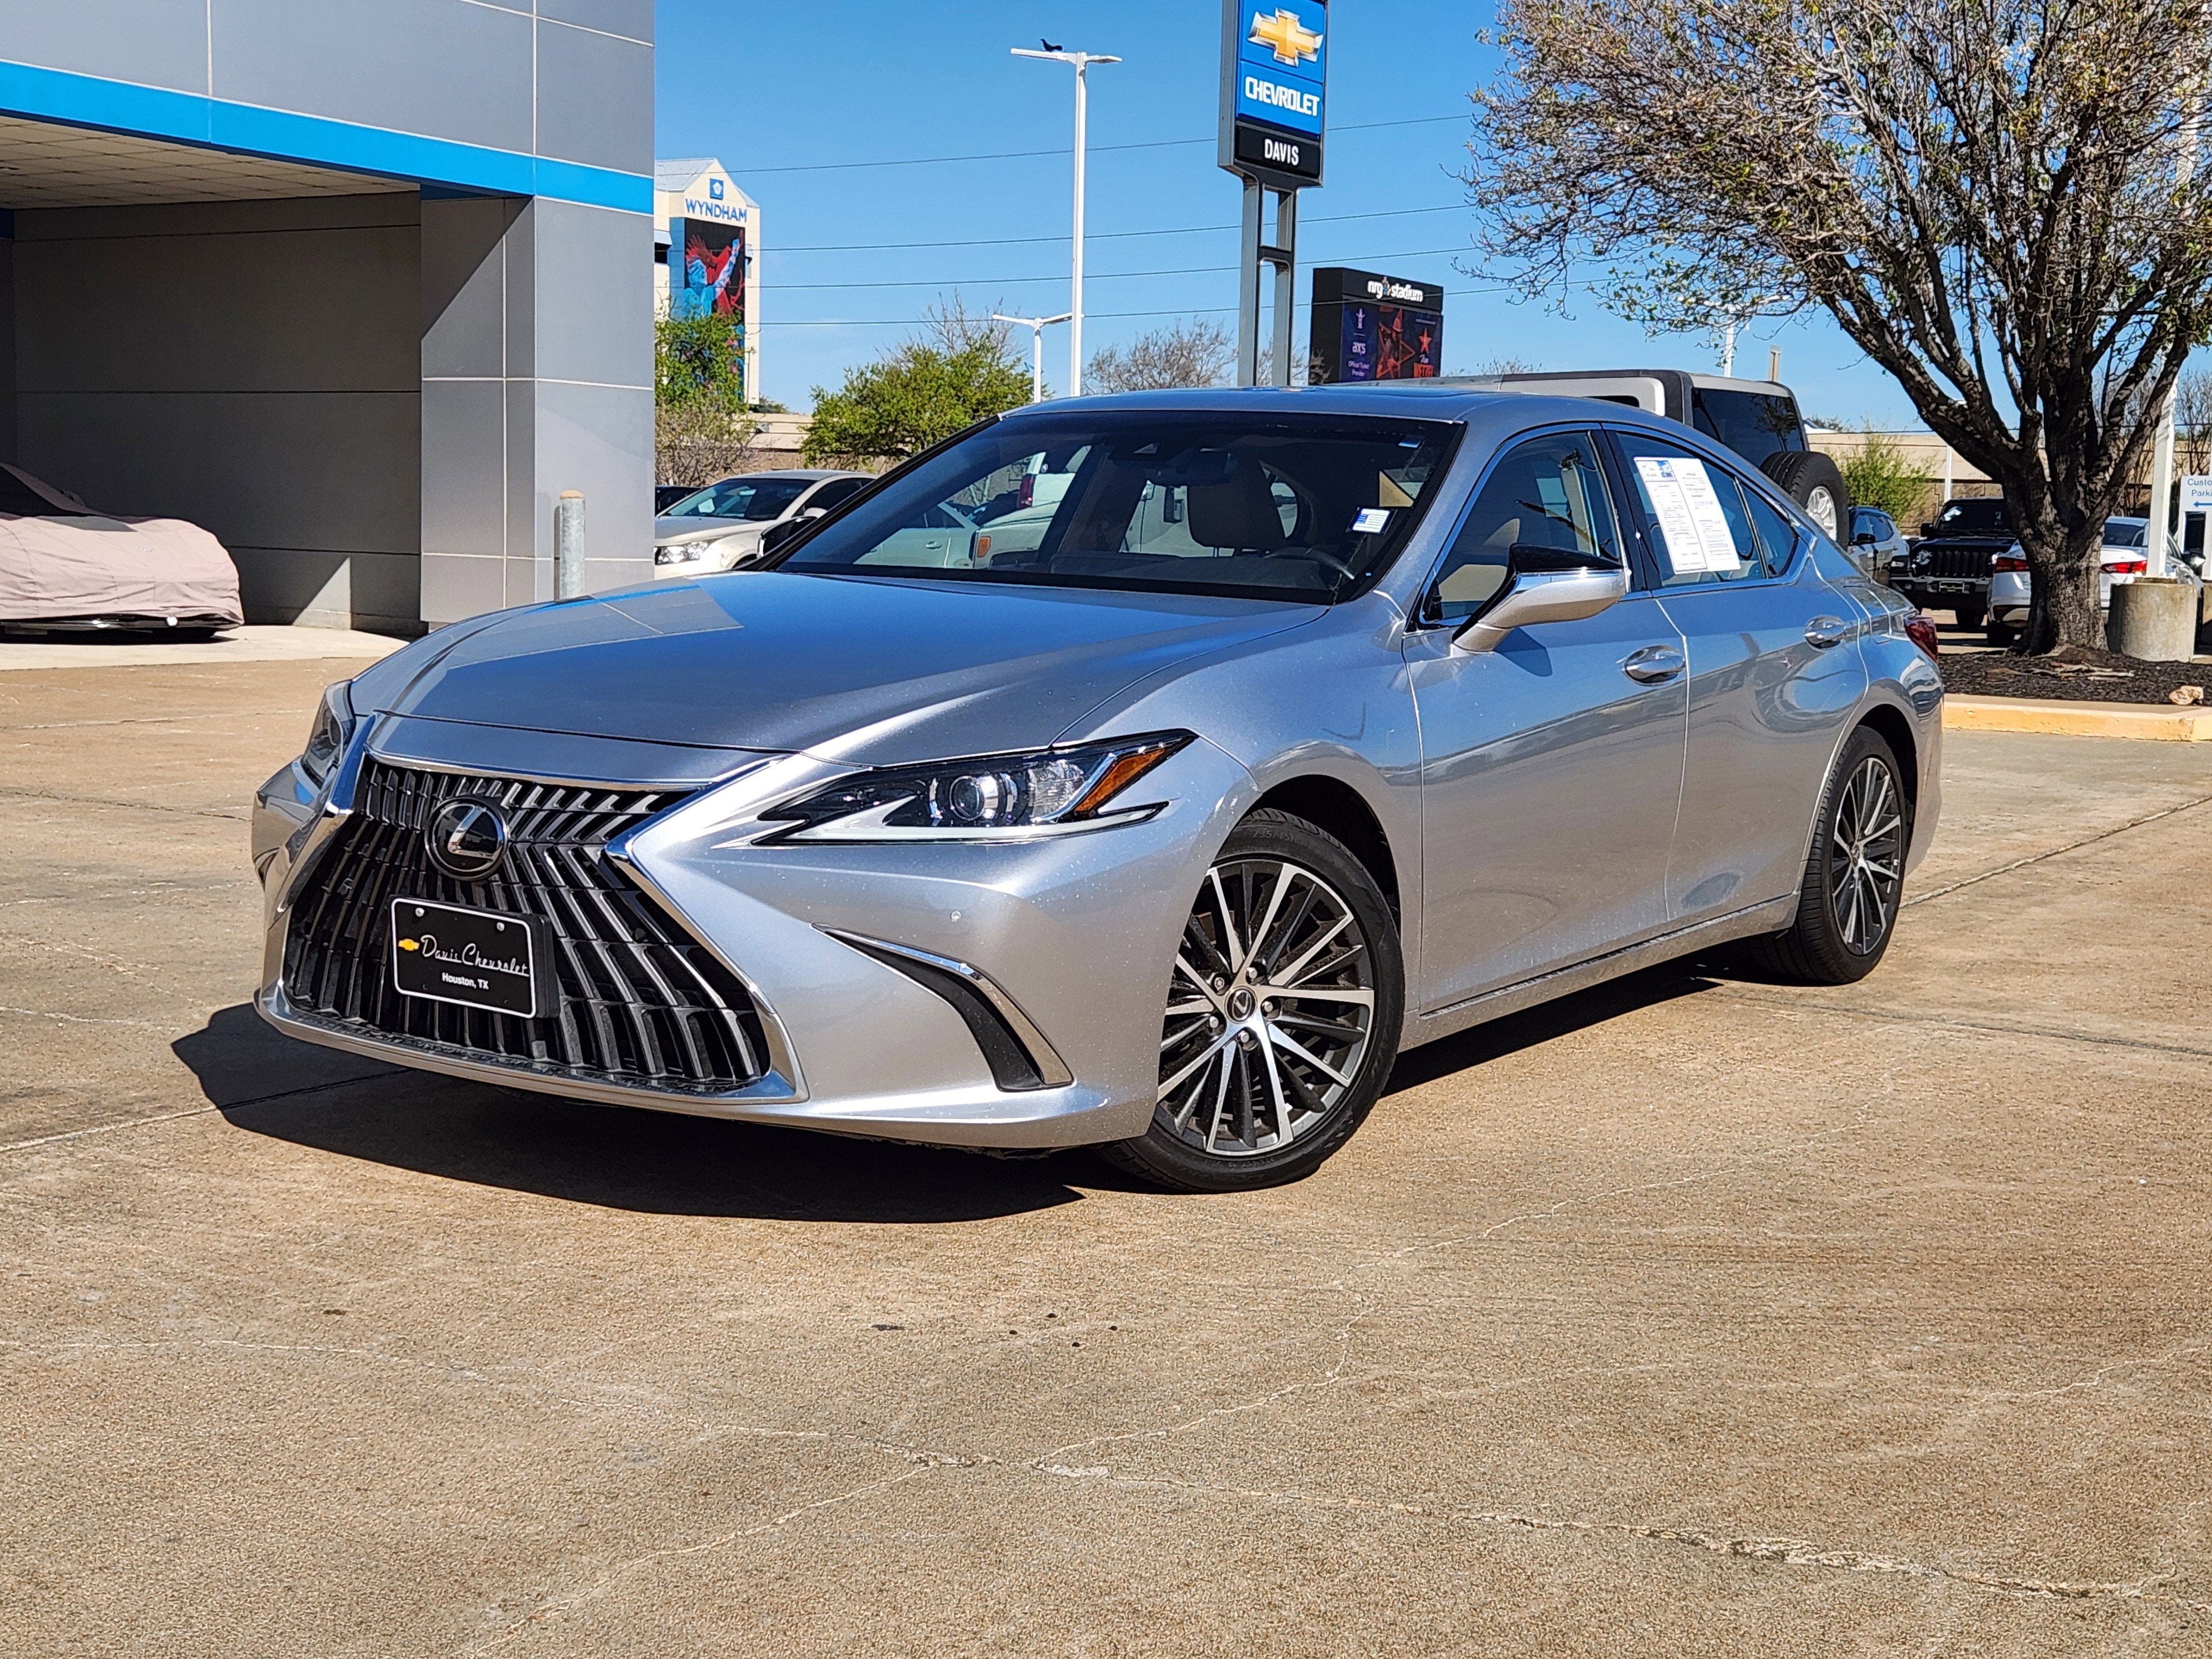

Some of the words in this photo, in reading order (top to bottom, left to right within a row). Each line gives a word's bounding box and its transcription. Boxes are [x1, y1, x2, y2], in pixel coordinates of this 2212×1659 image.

[1245, 76, 1320, 117] CHEVROLET
[1264, 139, 1299, 166] DAVIS
[685, 198, 748, 223] WYNDHAM
[1367, 280, 1383, 299] nrg
[1391, 283, 1423, 302] stadium
[420, 934, 462, 963] Davis
[462, 942, 530, 977] Chevrolet
[442, 972, 476, 989] Houston,
[477, 978, 489, 990] TX
